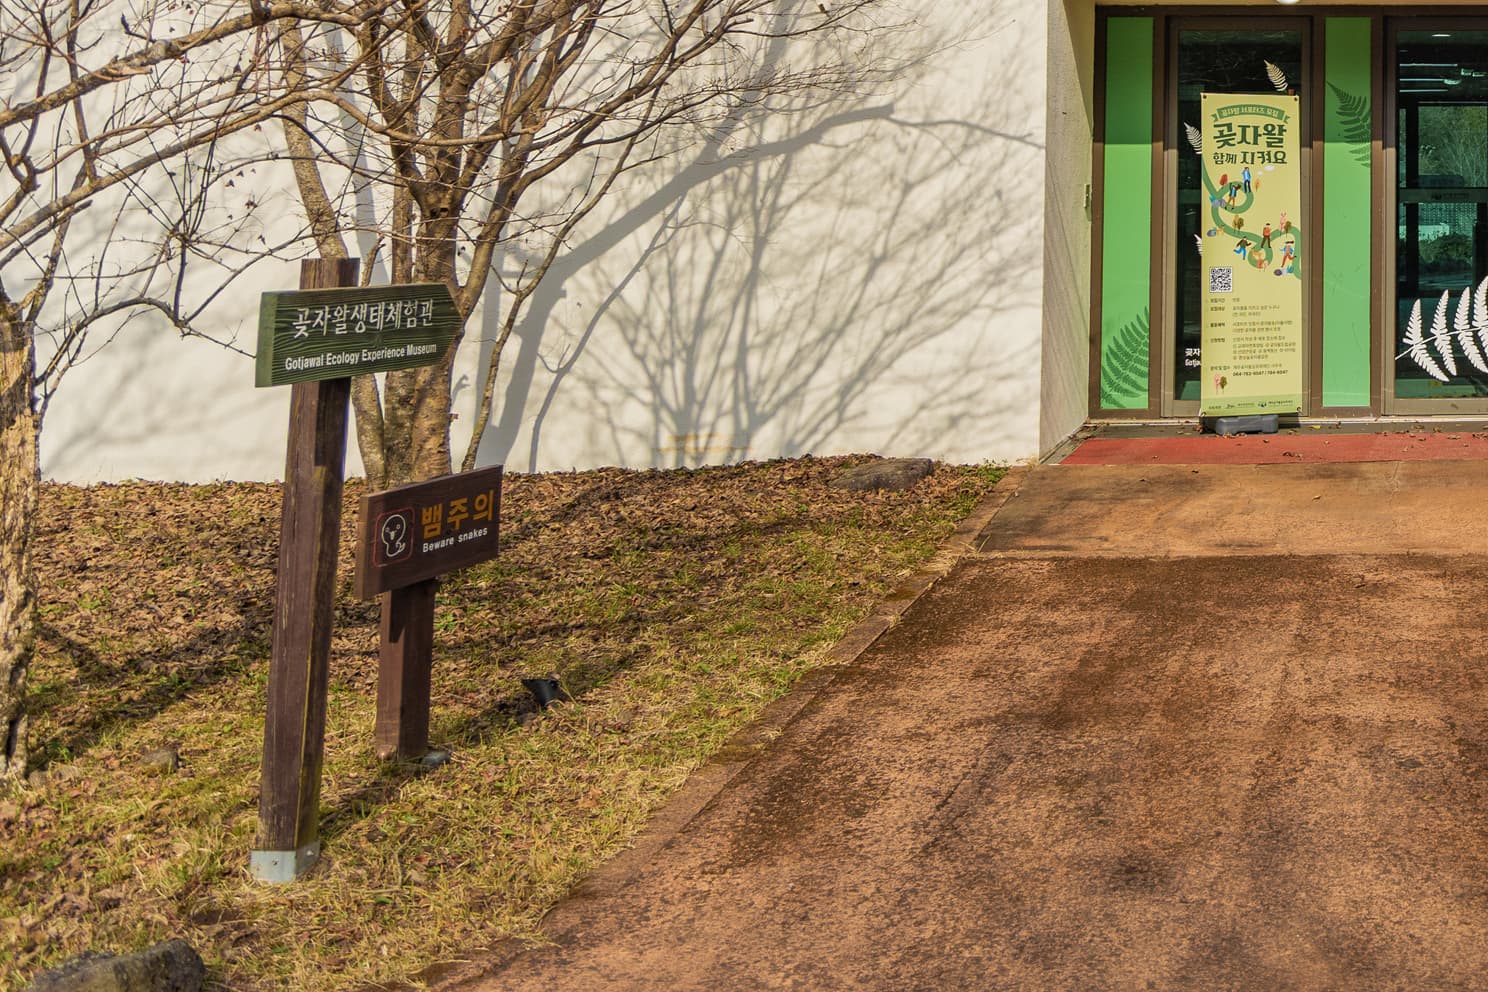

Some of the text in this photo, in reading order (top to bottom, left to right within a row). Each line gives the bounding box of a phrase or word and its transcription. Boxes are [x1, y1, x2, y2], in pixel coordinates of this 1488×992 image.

[1213, 122, 1287, 149] 곶자왈
[1213, 150, 1288, 165] 함께 지켜요
[292, 299, 434, 339] 곶자왈생태체험관
[285, 343, 437, 371] Gotjawal Ecology Experience Museum
[421, 489, 495, 539] 뱀주의
[422, 527, 488, 552] Beware snakes
